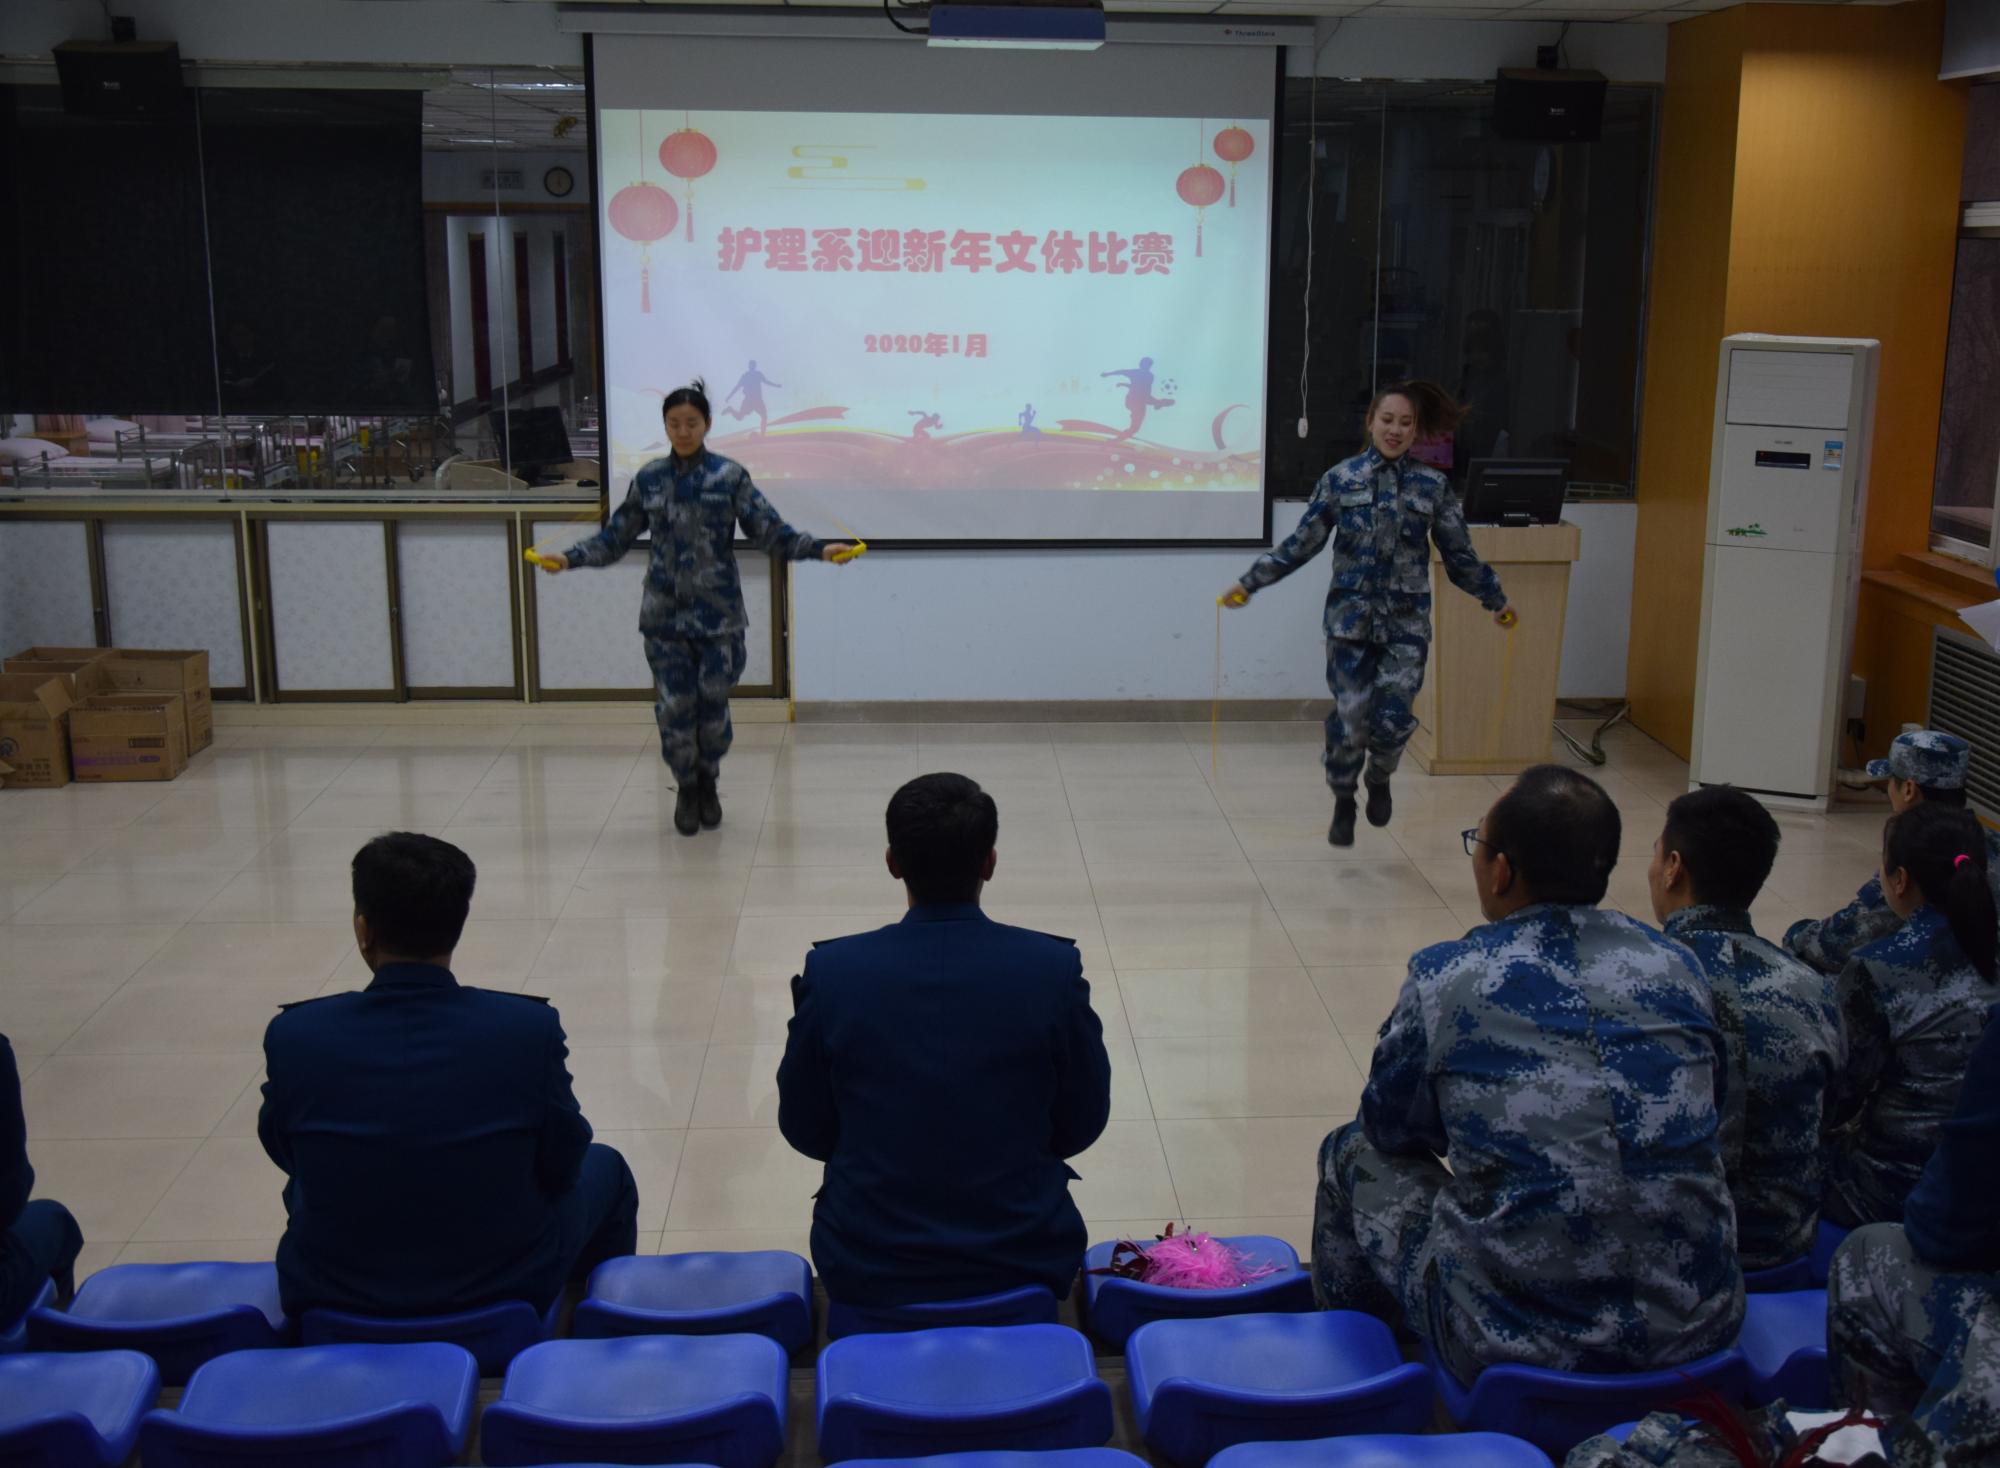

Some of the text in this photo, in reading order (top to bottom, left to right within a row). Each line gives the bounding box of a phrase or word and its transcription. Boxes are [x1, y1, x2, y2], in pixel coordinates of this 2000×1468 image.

[718, 227, 1174, 275] 护理系迎新年文体比赛
[864, 333, 988, 358] 2020年1月
